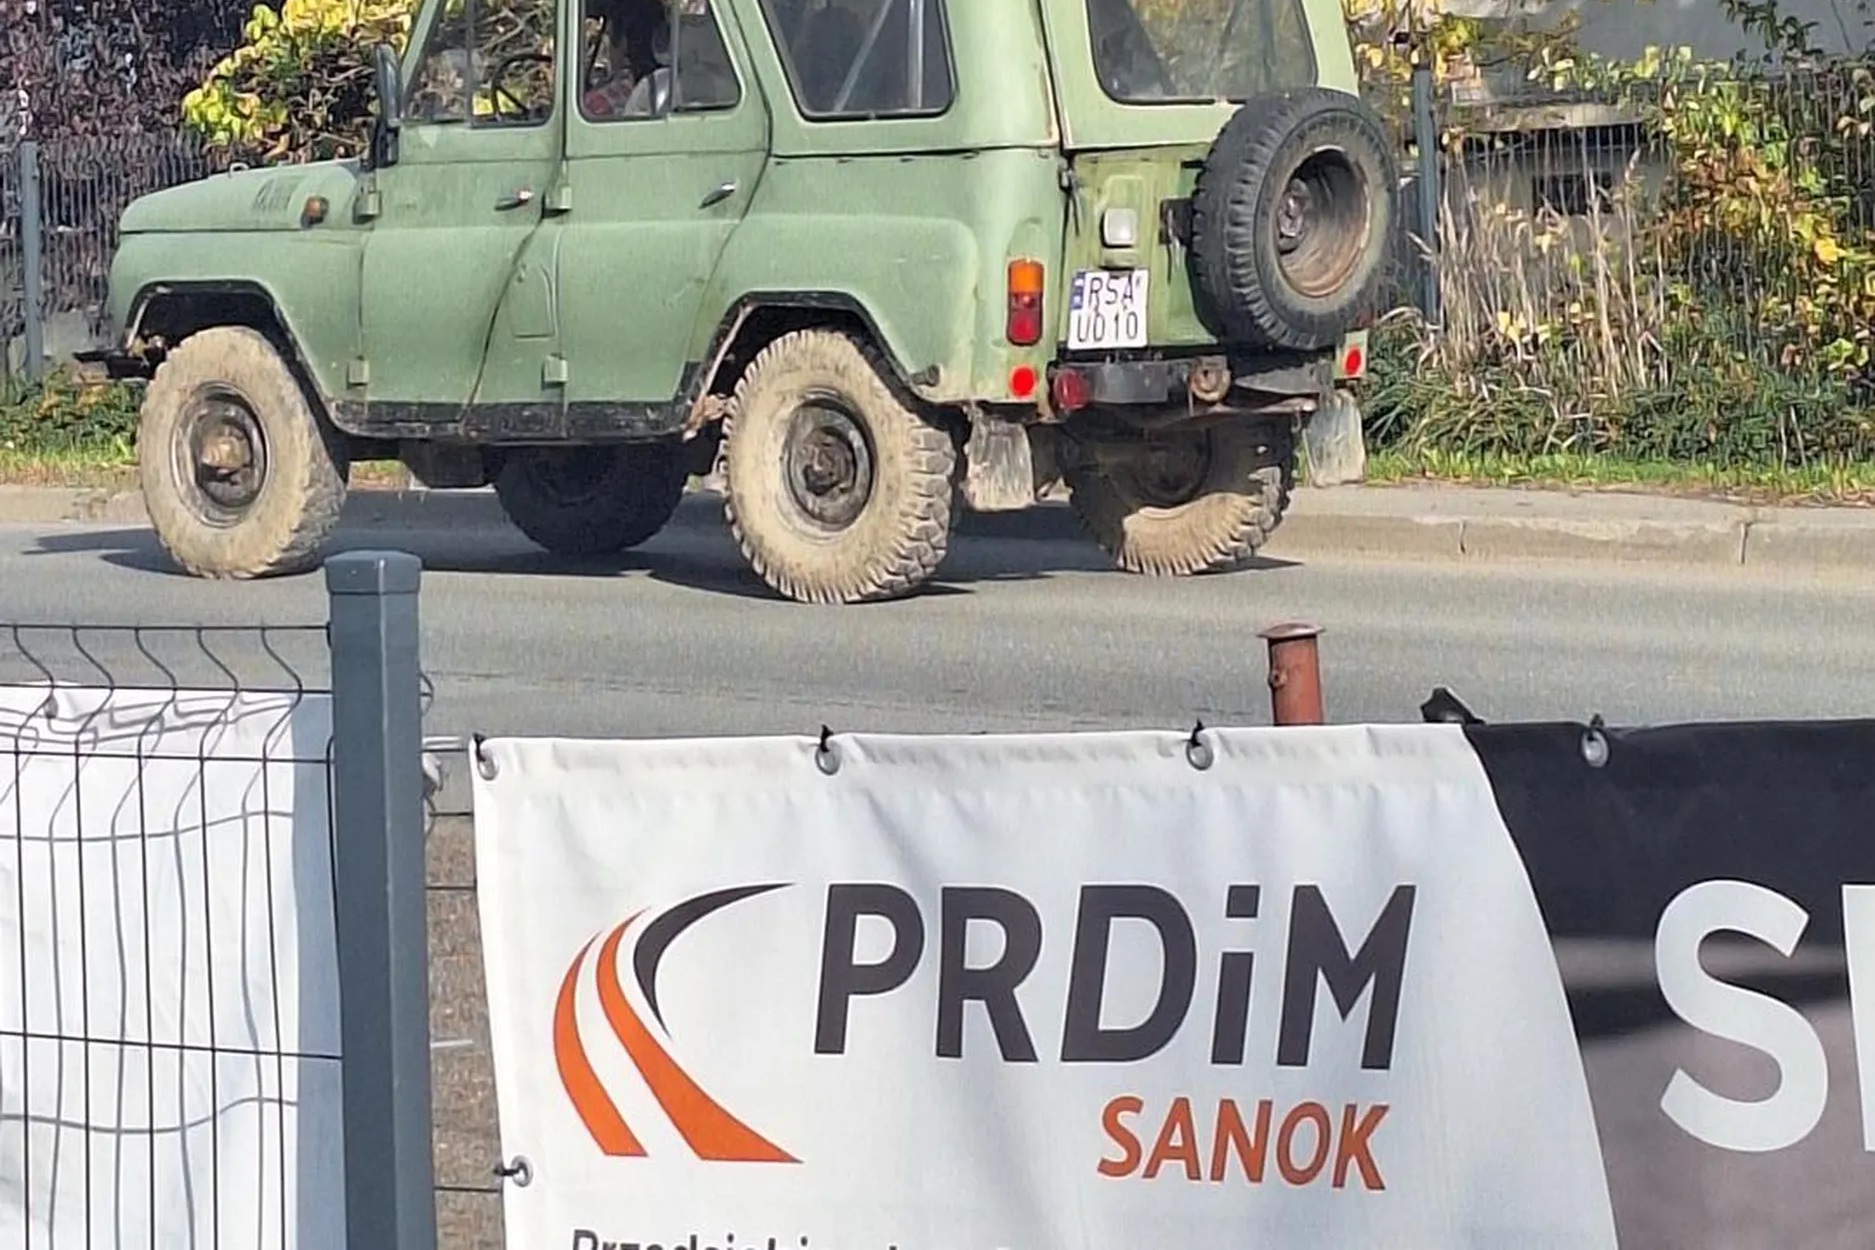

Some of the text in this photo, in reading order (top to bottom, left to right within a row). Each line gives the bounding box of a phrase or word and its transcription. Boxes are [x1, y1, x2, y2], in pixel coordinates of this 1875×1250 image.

[1087, 274, 1134, 307] RSA
[813, 882, 1417, 1071] PRDiM
[1096, 1095, 1390, 1191] SANOK
